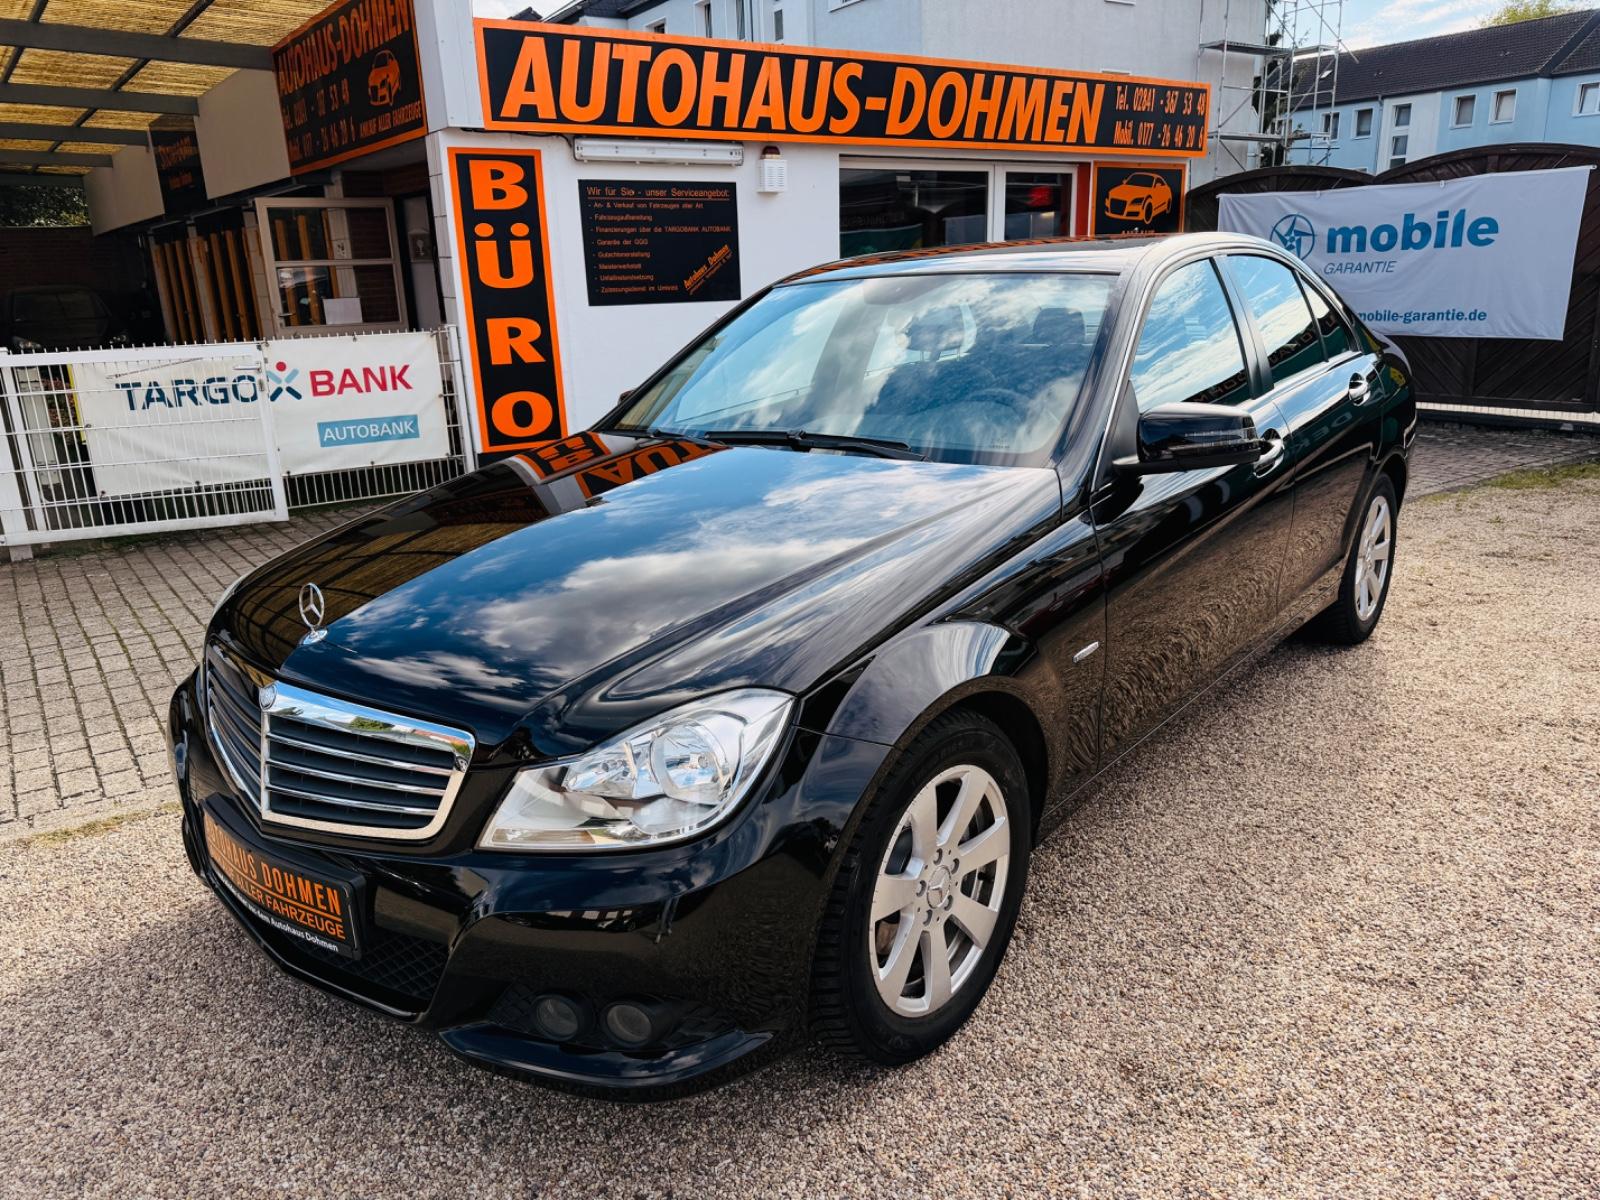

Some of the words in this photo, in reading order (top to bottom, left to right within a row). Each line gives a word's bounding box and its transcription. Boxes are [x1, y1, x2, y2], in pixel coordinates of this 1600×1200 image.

[499, 36, 1105, 144] AUTOHAUS-DOHMEN
[1115, 85, 1129, 111] Tel.
[1133, 87, 1156, 112] 02841
[1182, 92, 1193, 115] 53
[1196, 93, 1206, 116] 48
[1113, 120, 1134, 145] Mobil.
[1137, 121, 1155, 146] 0177
[1198, 126, 1205, 148] 6
[586, 186, 600, 196] Wir
[605, 186, 616, 196] für
[620, 187, 635, 197] Sie
[646, 188, 667, 197] unser
[671, 187, 731, 199] Serviceangebot:
[665, 225, 700, 233] TARGOBANK
[1326, 208, 1499, 254] mobile
[1323, 260, 1397, 275] GARANTIE
[115, 374, 258, 411] TARGO
[309, 364, 413, 398] BANK
[323, 420, 415, 442] AUTOBANK
[261, 861, 341, 916] DOHMEN
[265, 894, 346, 941] FAHRZEUGE
[270, 917, 305, 939] Autohaus
[305, 932, 339, 952] Dohmen
